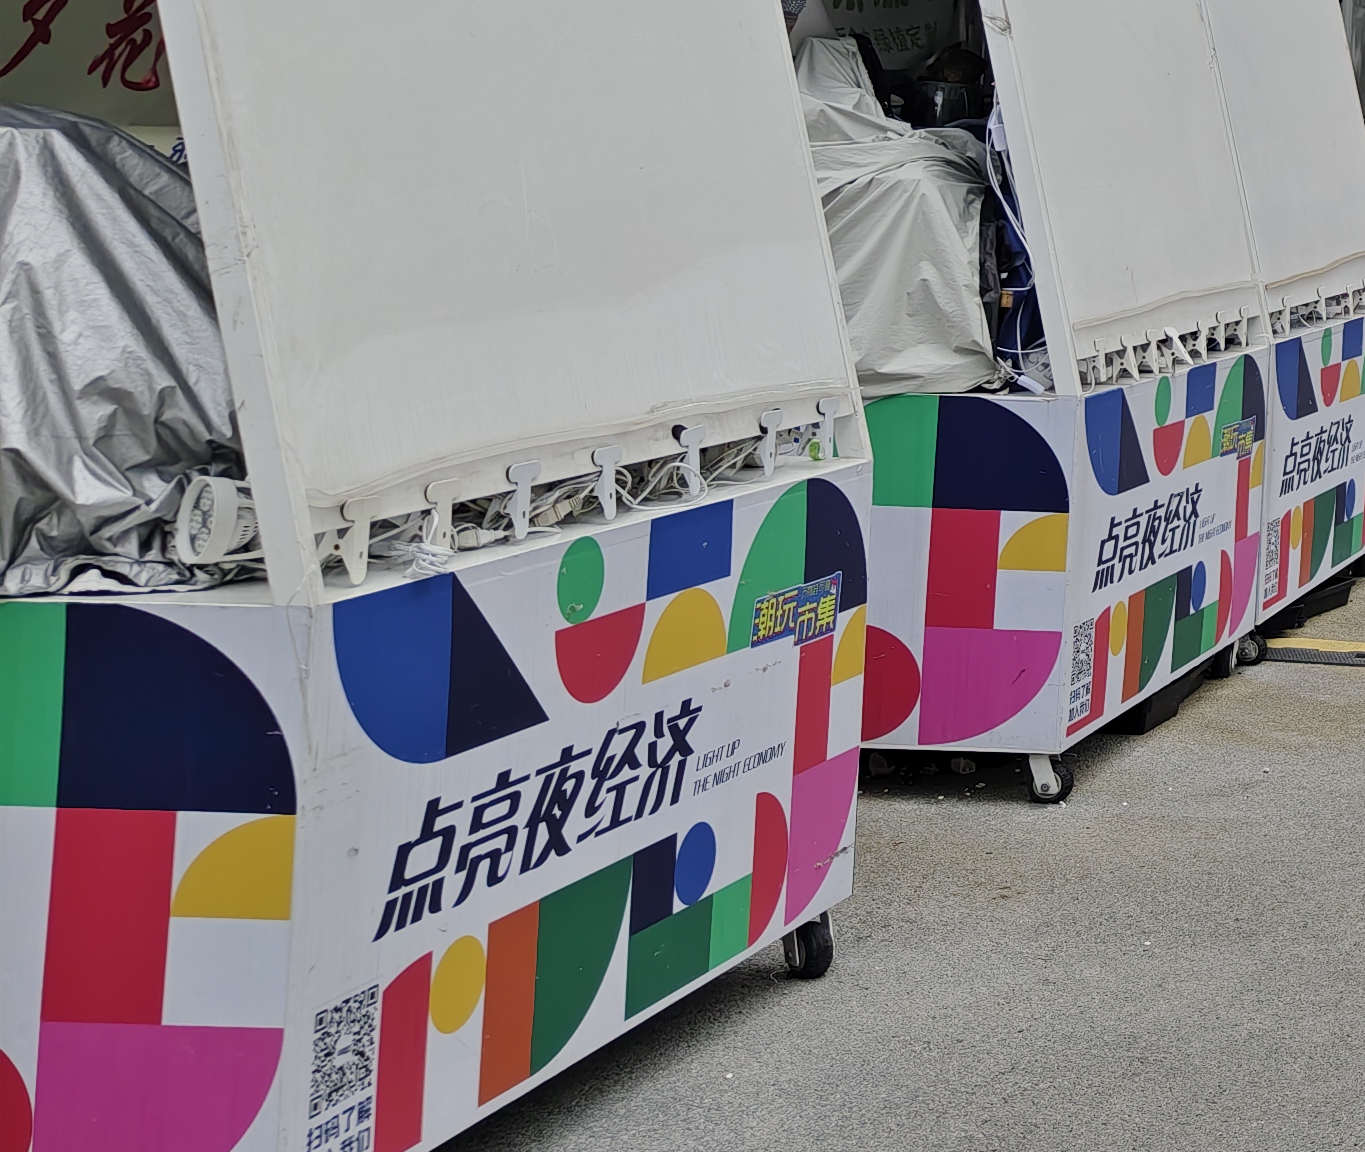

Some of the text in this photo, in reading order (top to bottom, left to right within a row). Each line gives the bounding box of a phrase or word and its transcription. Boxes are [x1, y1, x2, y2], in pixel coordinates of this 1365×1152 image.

[1279, 413, 1354, 497] 点亮夜经济
[1092, 482, 1203, 594] 点亮夜经济
[752, 589, 836, 643] 潮玩市集
[692, 740, 787, 797] THE NIGHT ECONOMY
[695, 738, 741, 772] LIGHT UP
[372, 697, 703, 943] 点亮夜经济
